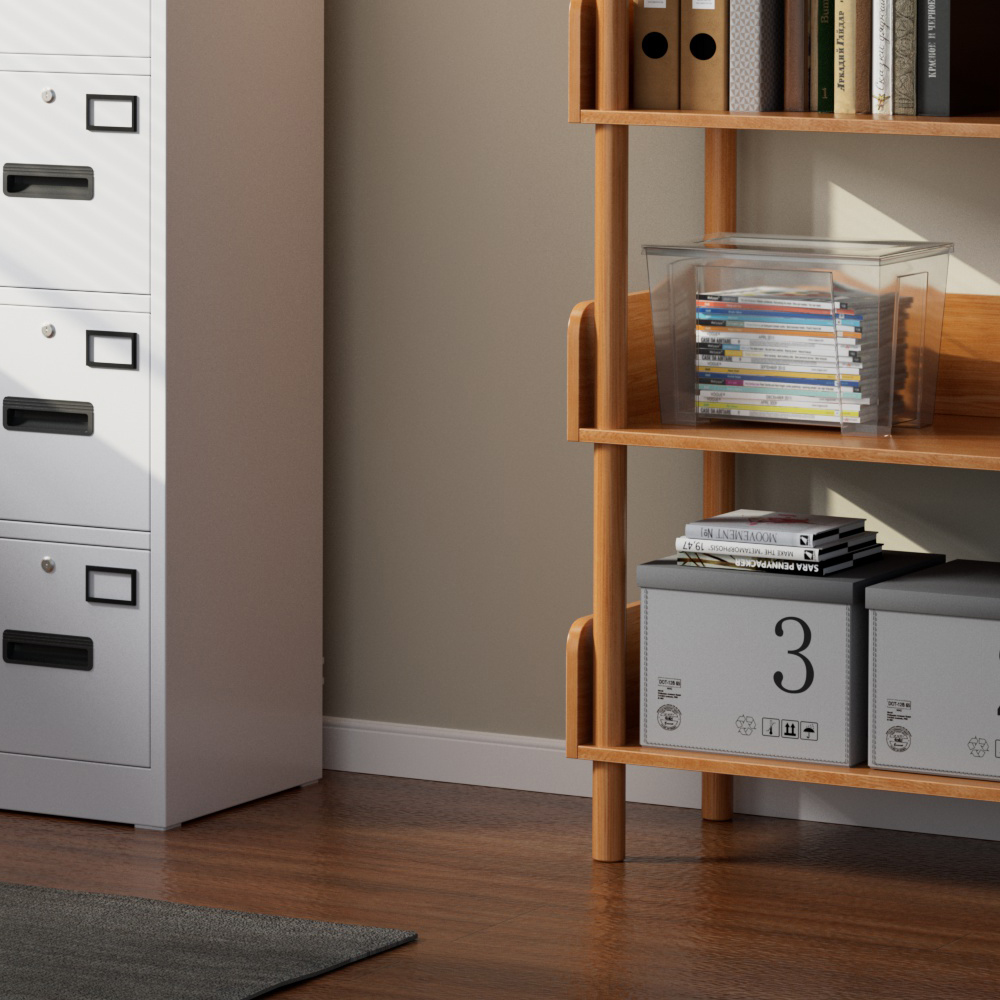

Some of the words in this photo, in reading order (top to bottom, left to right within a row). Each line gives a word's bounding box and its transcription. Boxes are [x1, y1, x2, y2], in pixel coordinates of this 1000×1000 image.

[927, 0, 936, 31] ЧЕРНОЕ
[928, 42, 936, 78] КРАСНОЕ
[717, 529, 777, 543] MOOVEMENT
[764, 548, 775, 556] THE
[777, 549, 794, 557] MAKE
[735, 558, 795, 571] PENNYPACKER
[796, 562, 819, 573] SARA
[773, 616, 815, 694] 3
